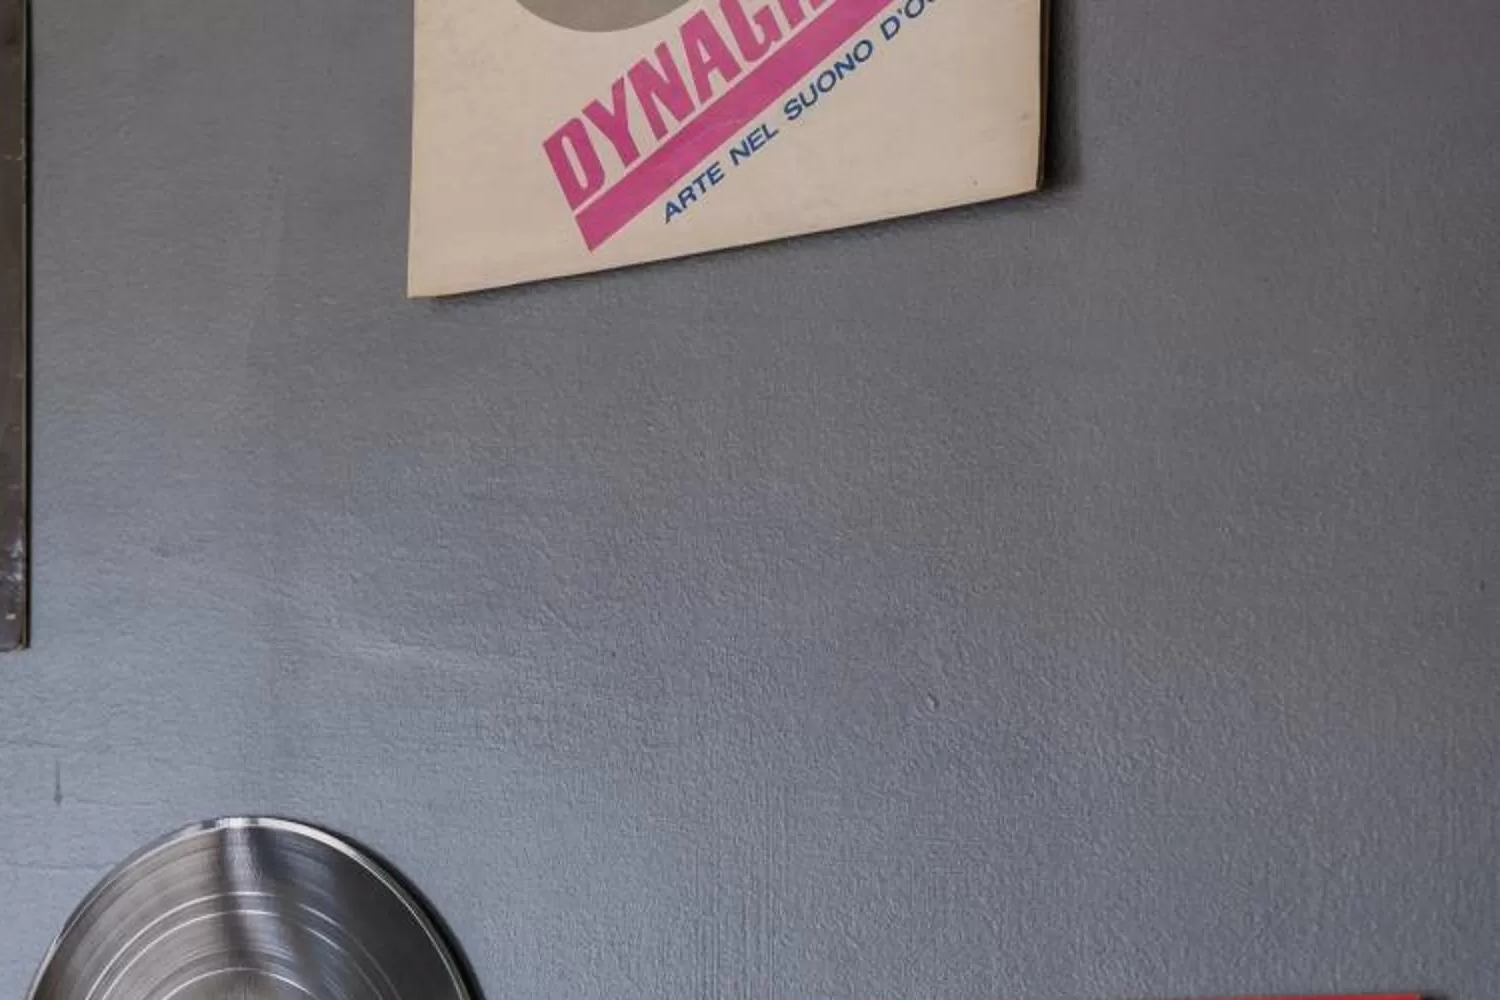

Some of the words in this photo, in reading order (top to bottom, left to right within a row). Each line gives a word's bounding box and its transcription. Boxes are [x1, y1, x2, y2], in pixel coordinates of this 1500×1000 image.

[663, 161, 725, 224] ARTE
[729, 123, 779, 167] NEL
[783, 39, 874, 121] SUONO
[880, 0, 938, 40] D'O
